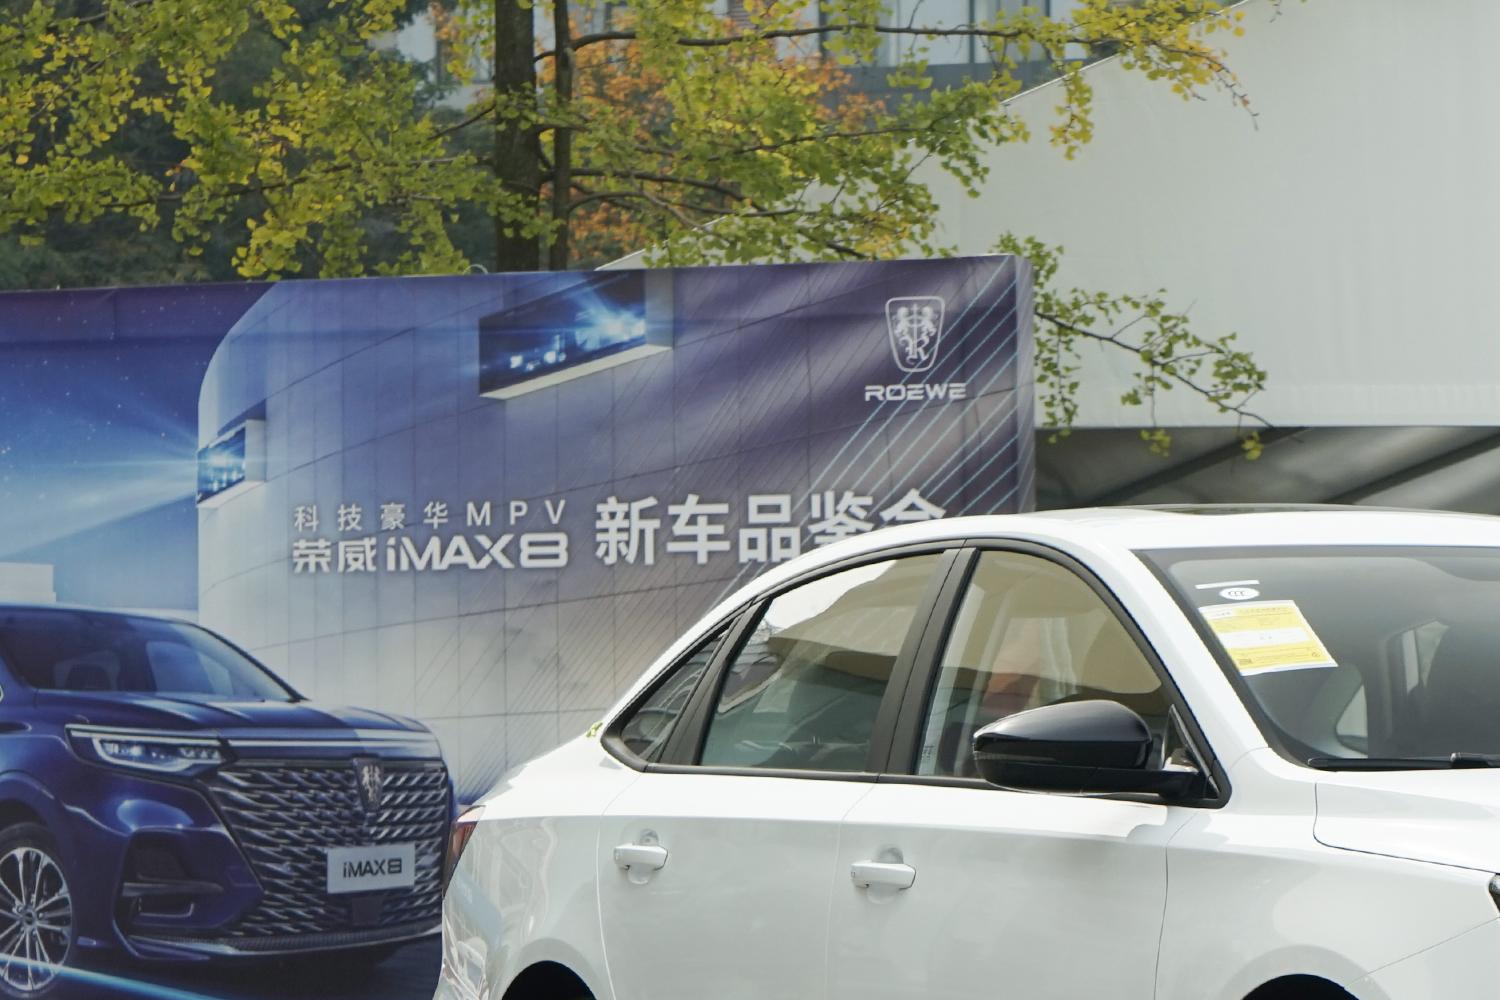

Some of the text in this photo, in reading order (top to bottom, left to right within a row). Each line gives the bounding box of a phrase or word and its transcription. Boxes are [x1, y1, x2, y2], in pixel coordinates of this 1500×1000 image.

[864, 382, 967, 402] ROEWE
[294, 499, 566, 532] 科技豪华MPV
[342, 857, 403, 878] iMAX8
